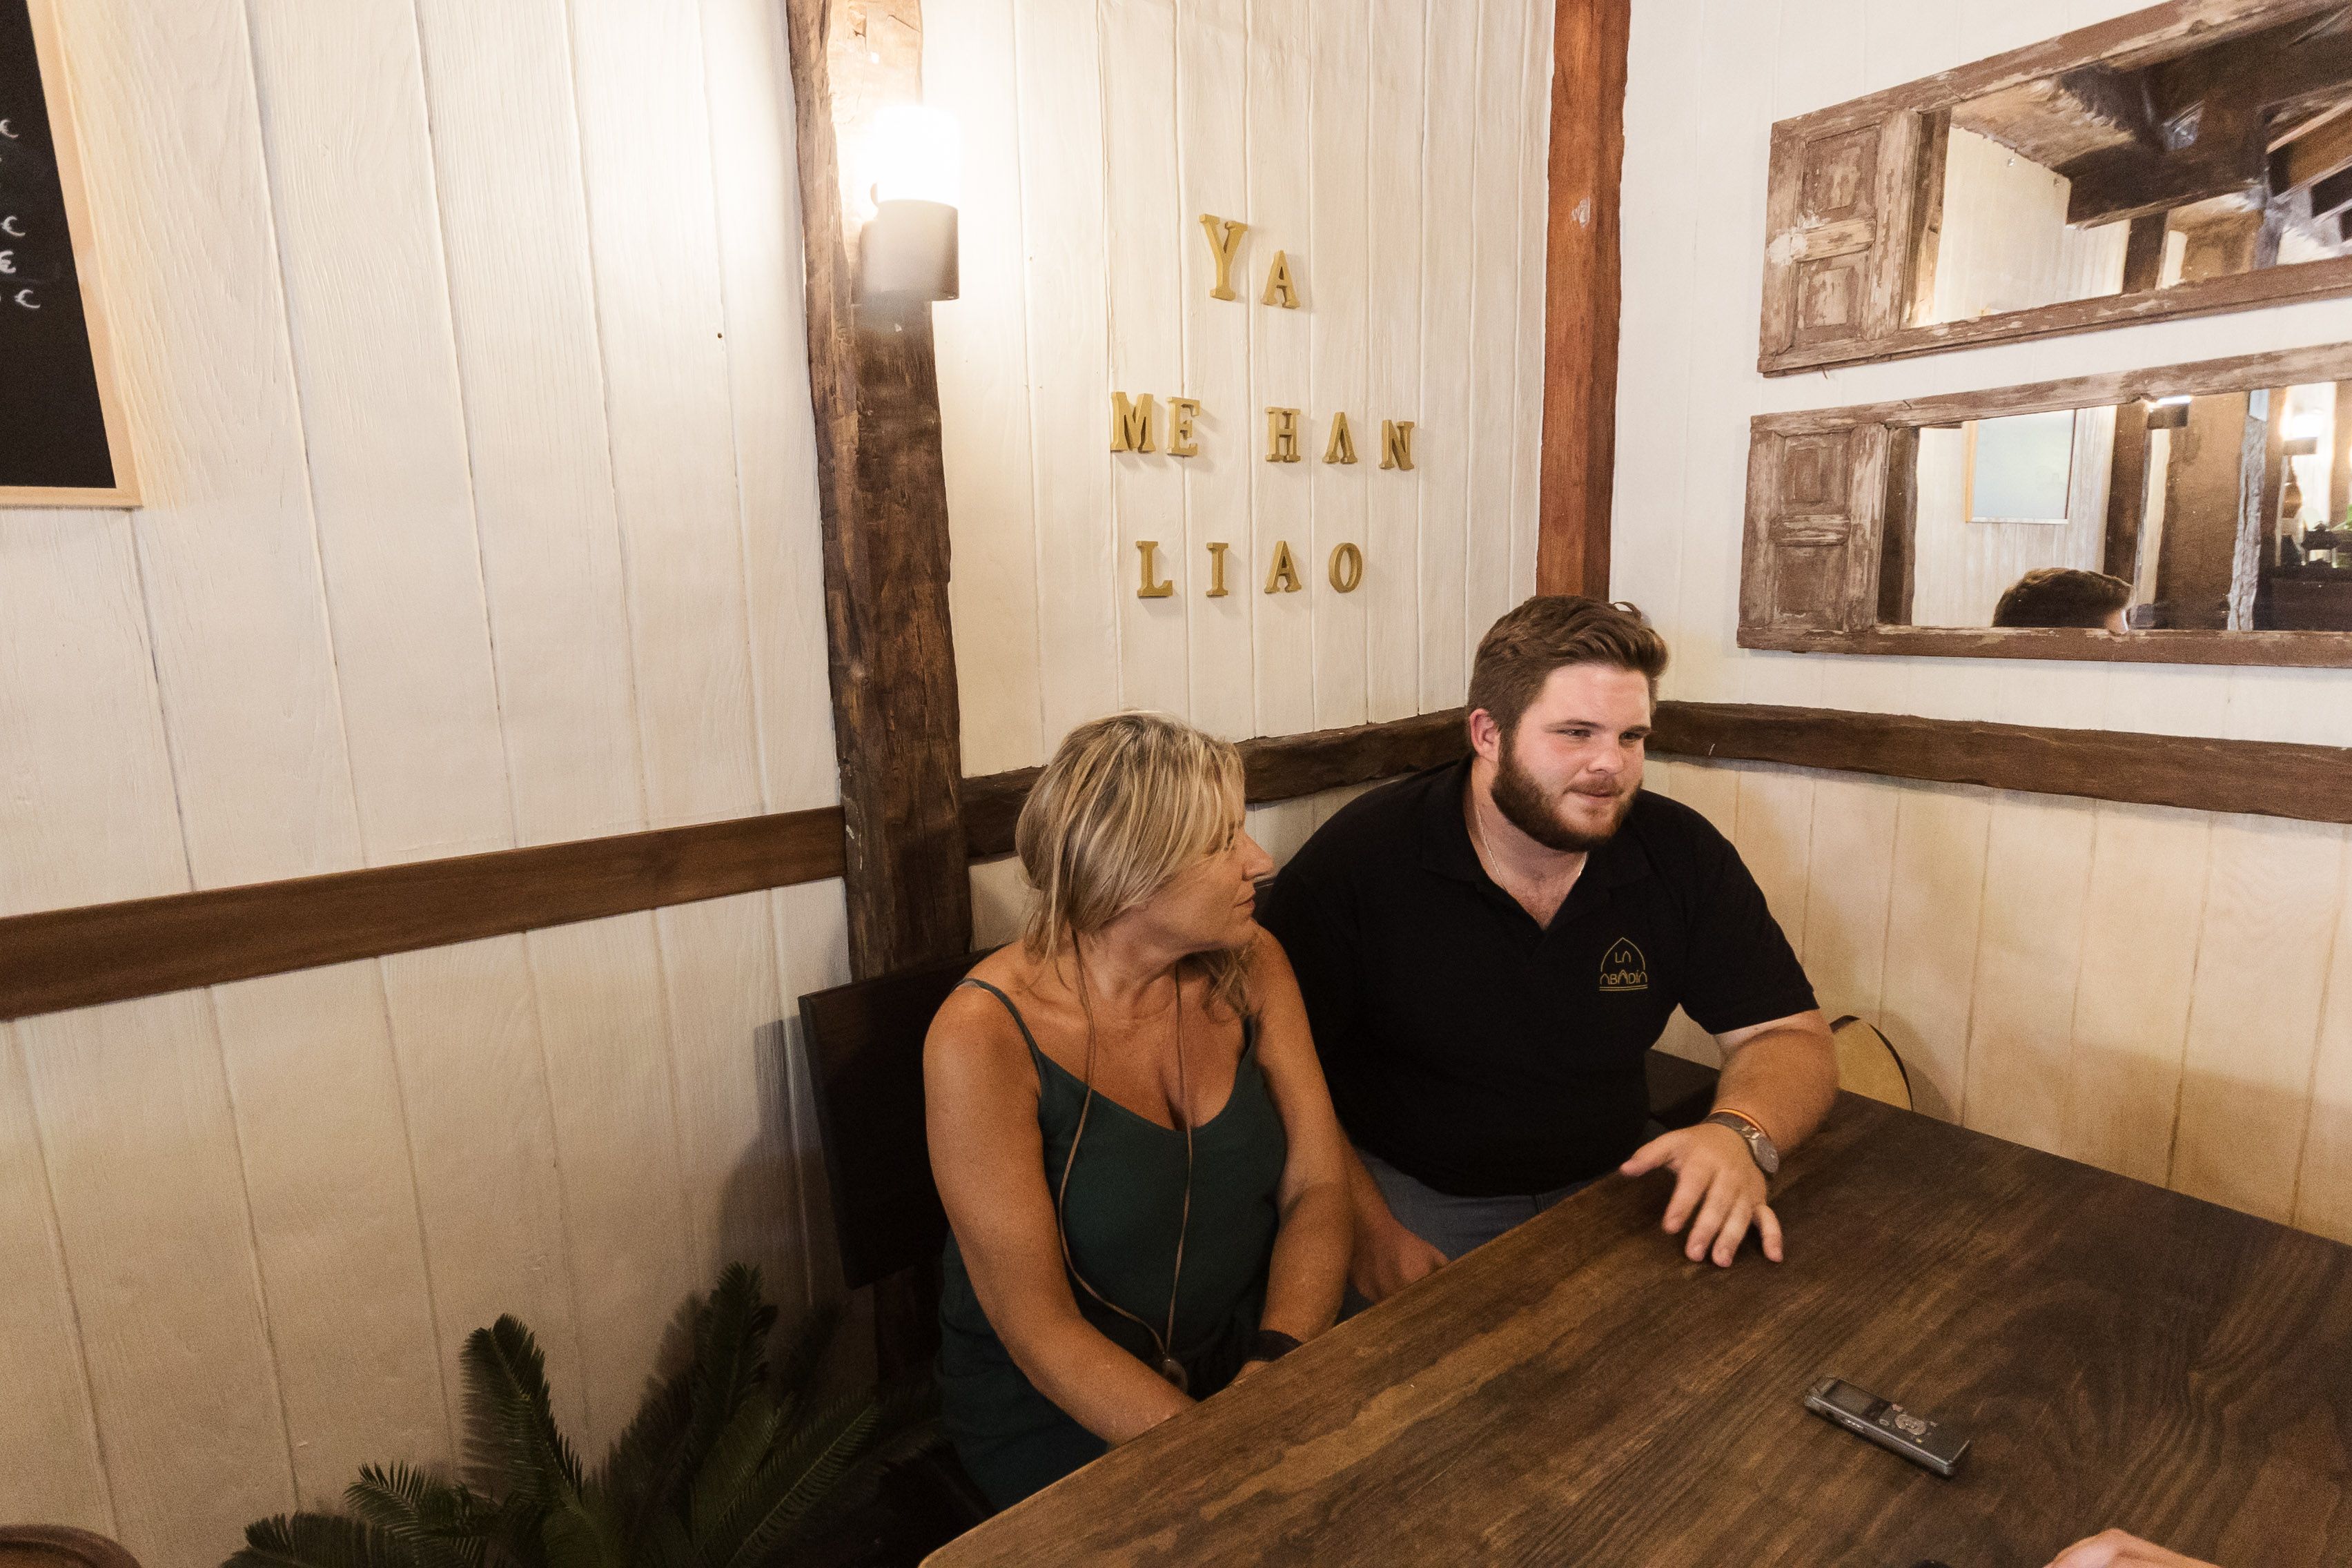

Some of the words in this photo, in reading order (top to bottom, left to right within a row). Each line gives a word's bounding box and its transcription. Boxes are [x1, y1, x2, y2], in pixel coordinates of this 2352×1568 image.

[1198, 213, 1301, 308] YA
[1110, 391, 1201, 458] ME
[1264, 406, 1415, 471] HAN
[1135, 540, 1363, 598] LIAO
[1615, 950, 1631, 963] LA
